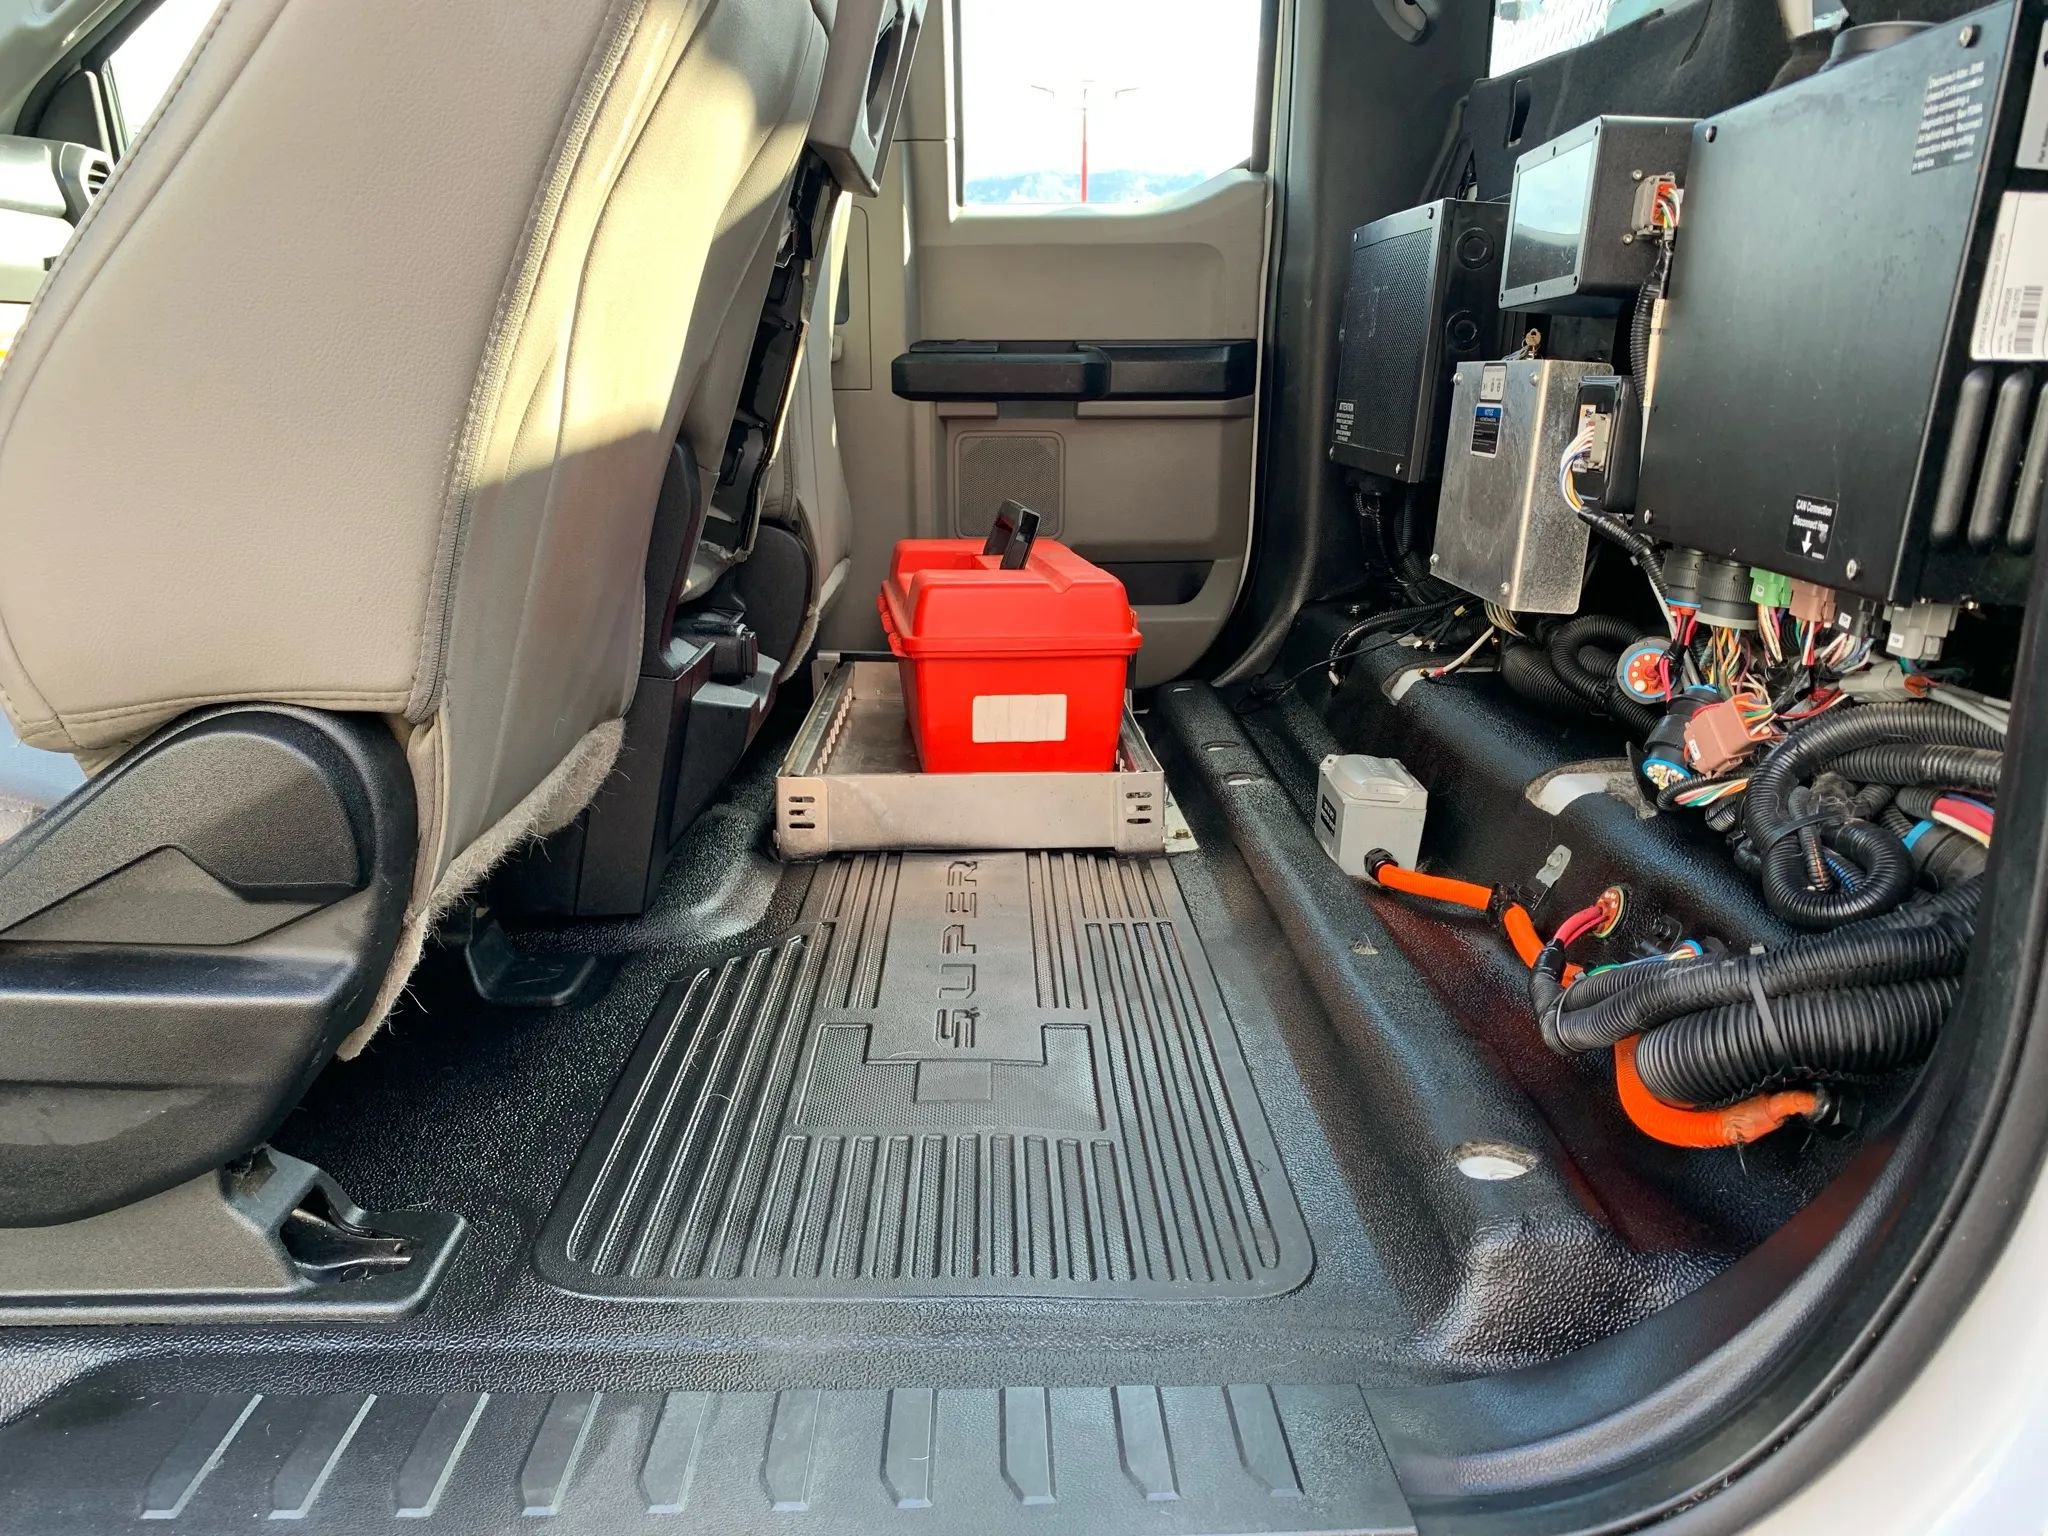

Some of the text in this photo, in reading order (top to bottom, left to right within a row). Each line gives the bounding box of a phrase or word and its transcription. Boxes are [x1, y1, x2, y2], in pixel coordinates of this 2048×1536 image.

[1796, 499, 1833, 517] CAN Connection
[1793, 514, 1818, 530] Disconnect
[934, 861, 979, 1048] SUPER
